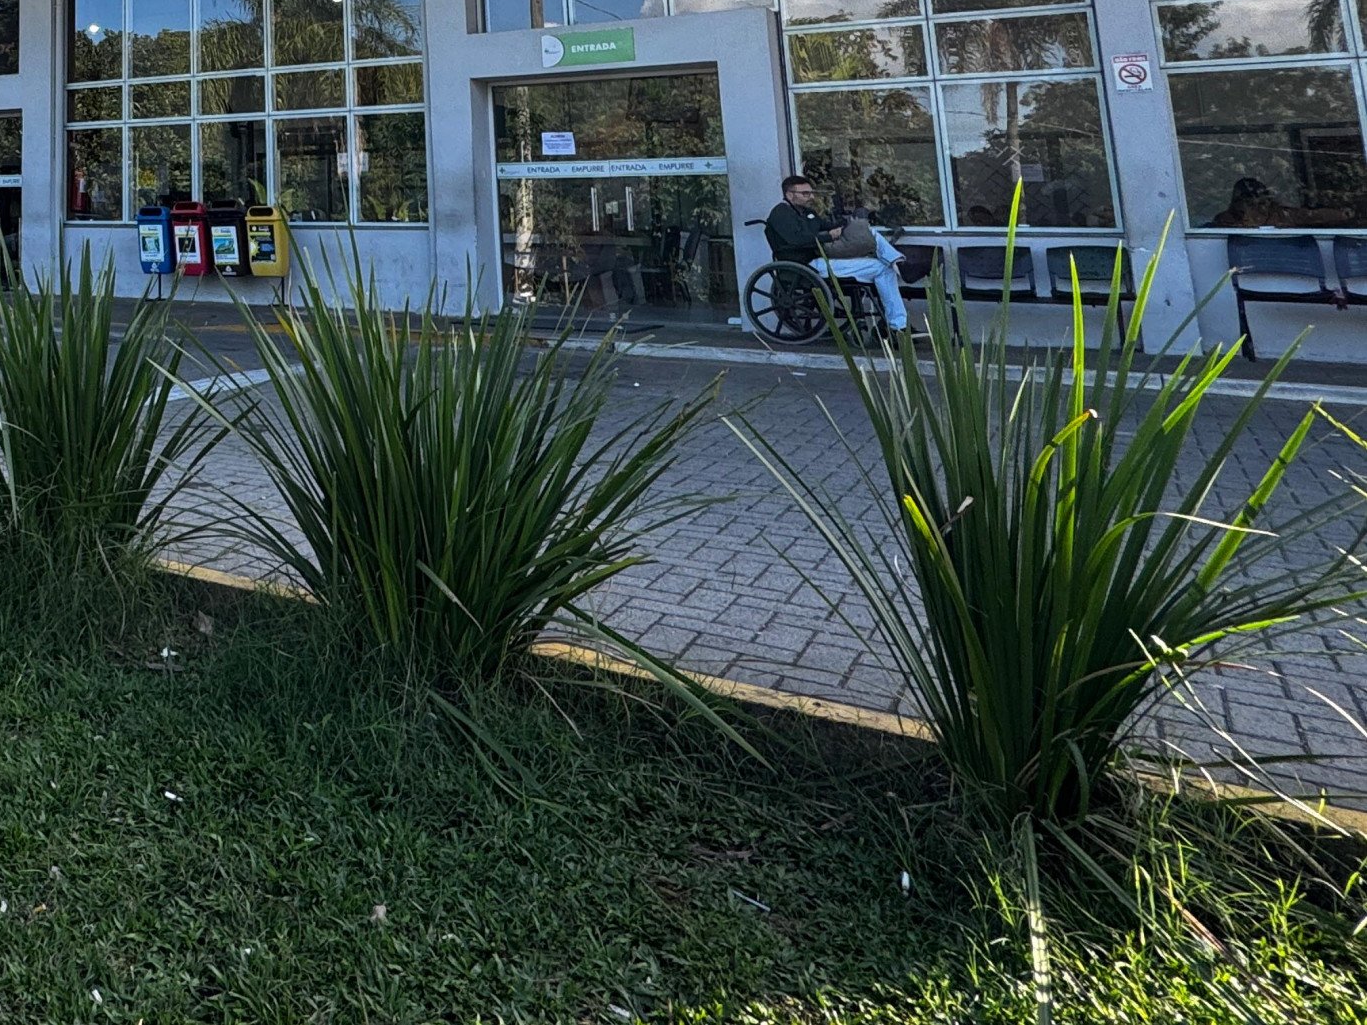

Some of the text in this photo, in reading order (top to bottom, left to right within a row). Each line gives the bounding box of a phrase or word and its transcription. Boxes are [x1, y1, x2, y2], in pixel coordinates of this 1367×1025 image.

[571, 42, 617, 53] ENTRADA
[527, 166, 560, 174] ENTRADA
[571, 165, 605, 173] EMPURRE
[610, 163, 647, 172] ENTRADA
